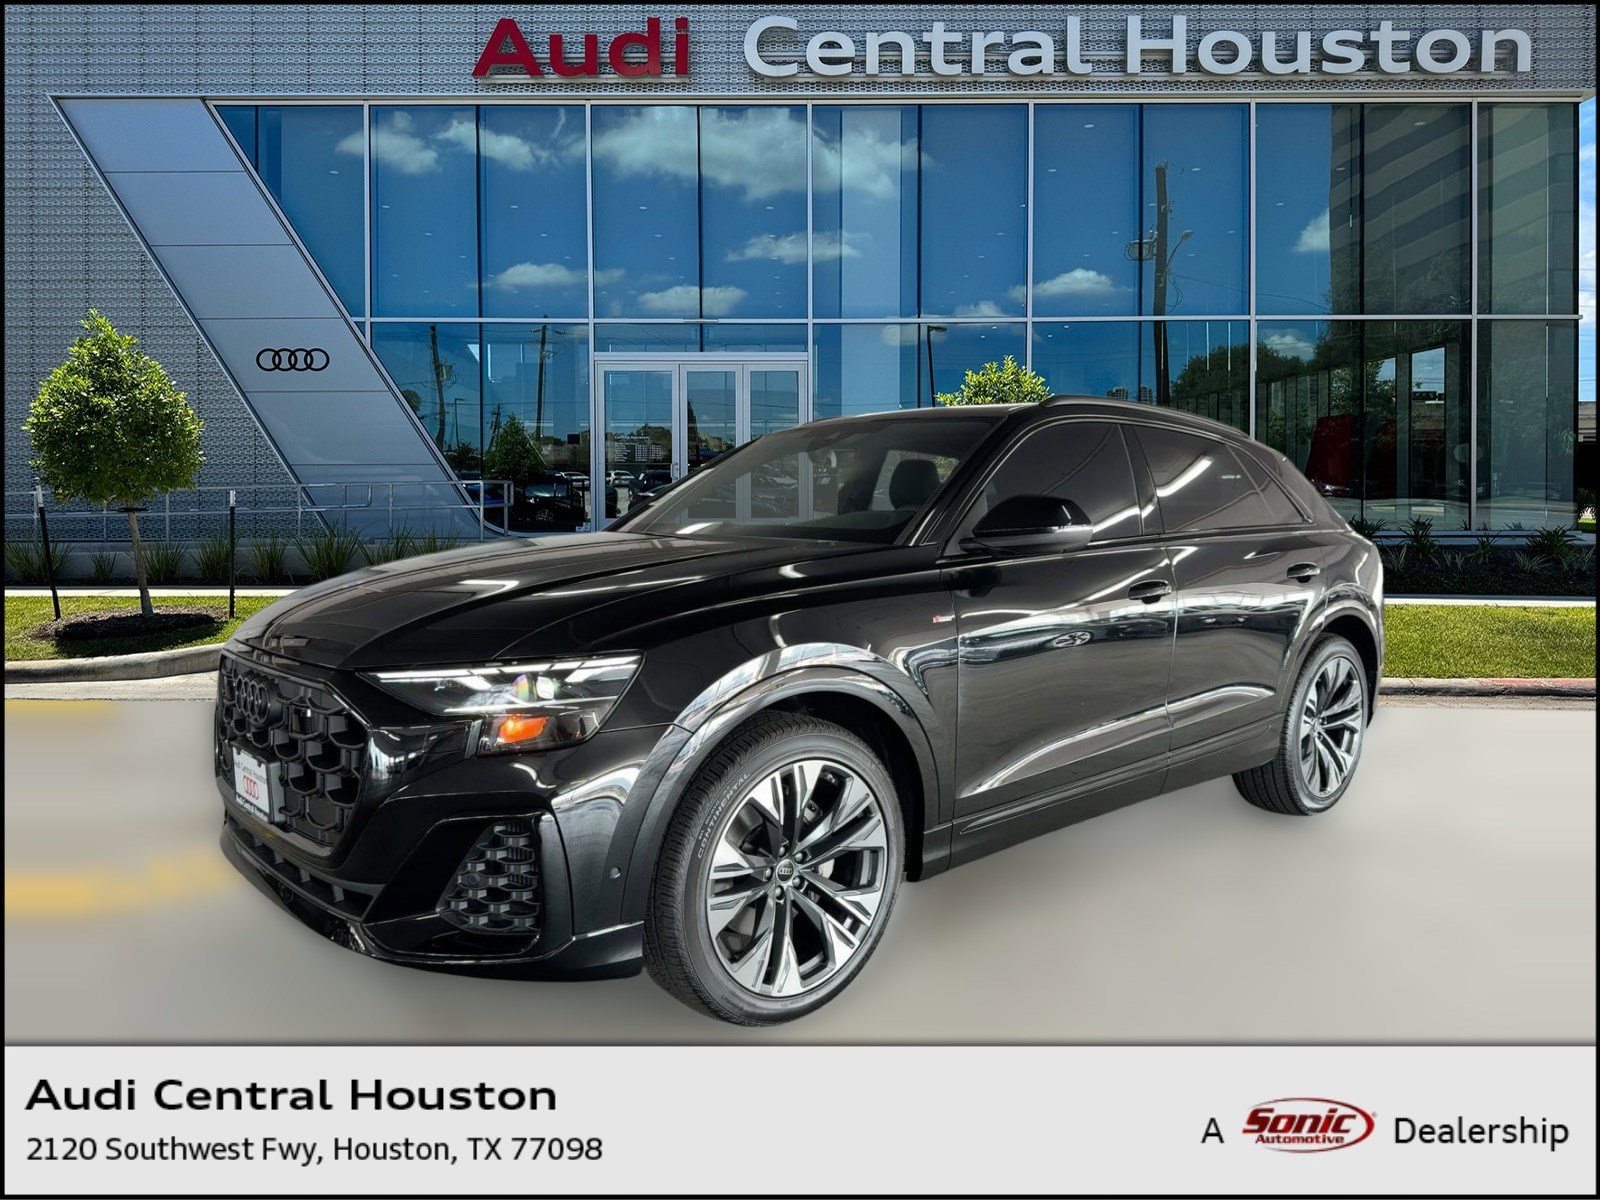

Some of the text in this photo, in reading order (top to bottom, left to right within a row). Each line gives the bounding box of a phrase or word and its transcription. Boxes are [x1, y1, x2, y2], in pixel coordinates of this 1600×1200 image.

[472, 15, 1532, 78] Audi Central Houston
[697, 772, 751, 859] CONTINENTAL
